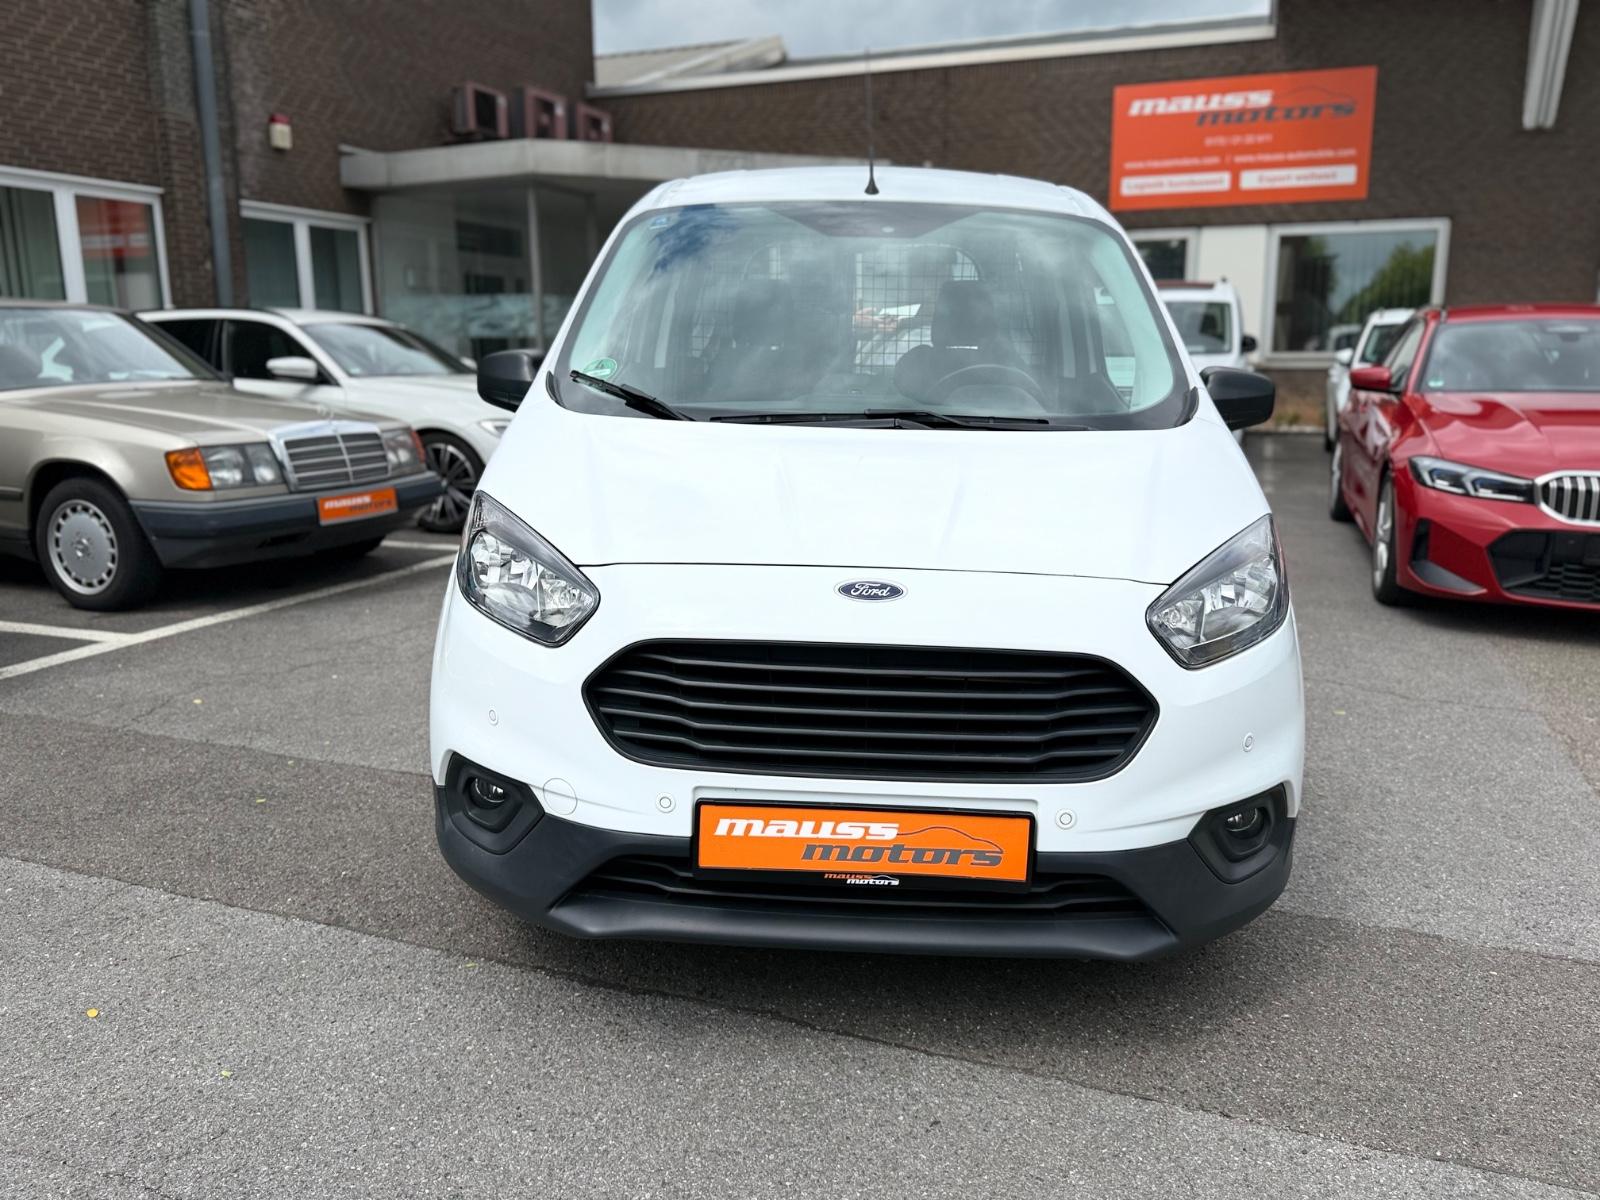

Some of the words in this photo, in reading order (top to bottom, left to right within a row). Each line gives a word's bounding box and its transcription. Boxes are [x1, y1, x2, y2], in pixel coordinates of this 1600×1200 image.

[1128, 90, 1274, 116] mauss
[1196, 101, 1357, 127] motors
[850, 582, 891, 597] Ford
[713, 818, 900, 840] mauss
[801, 843, 1003, 867] motors
[846, 878, 900, 886] motors
